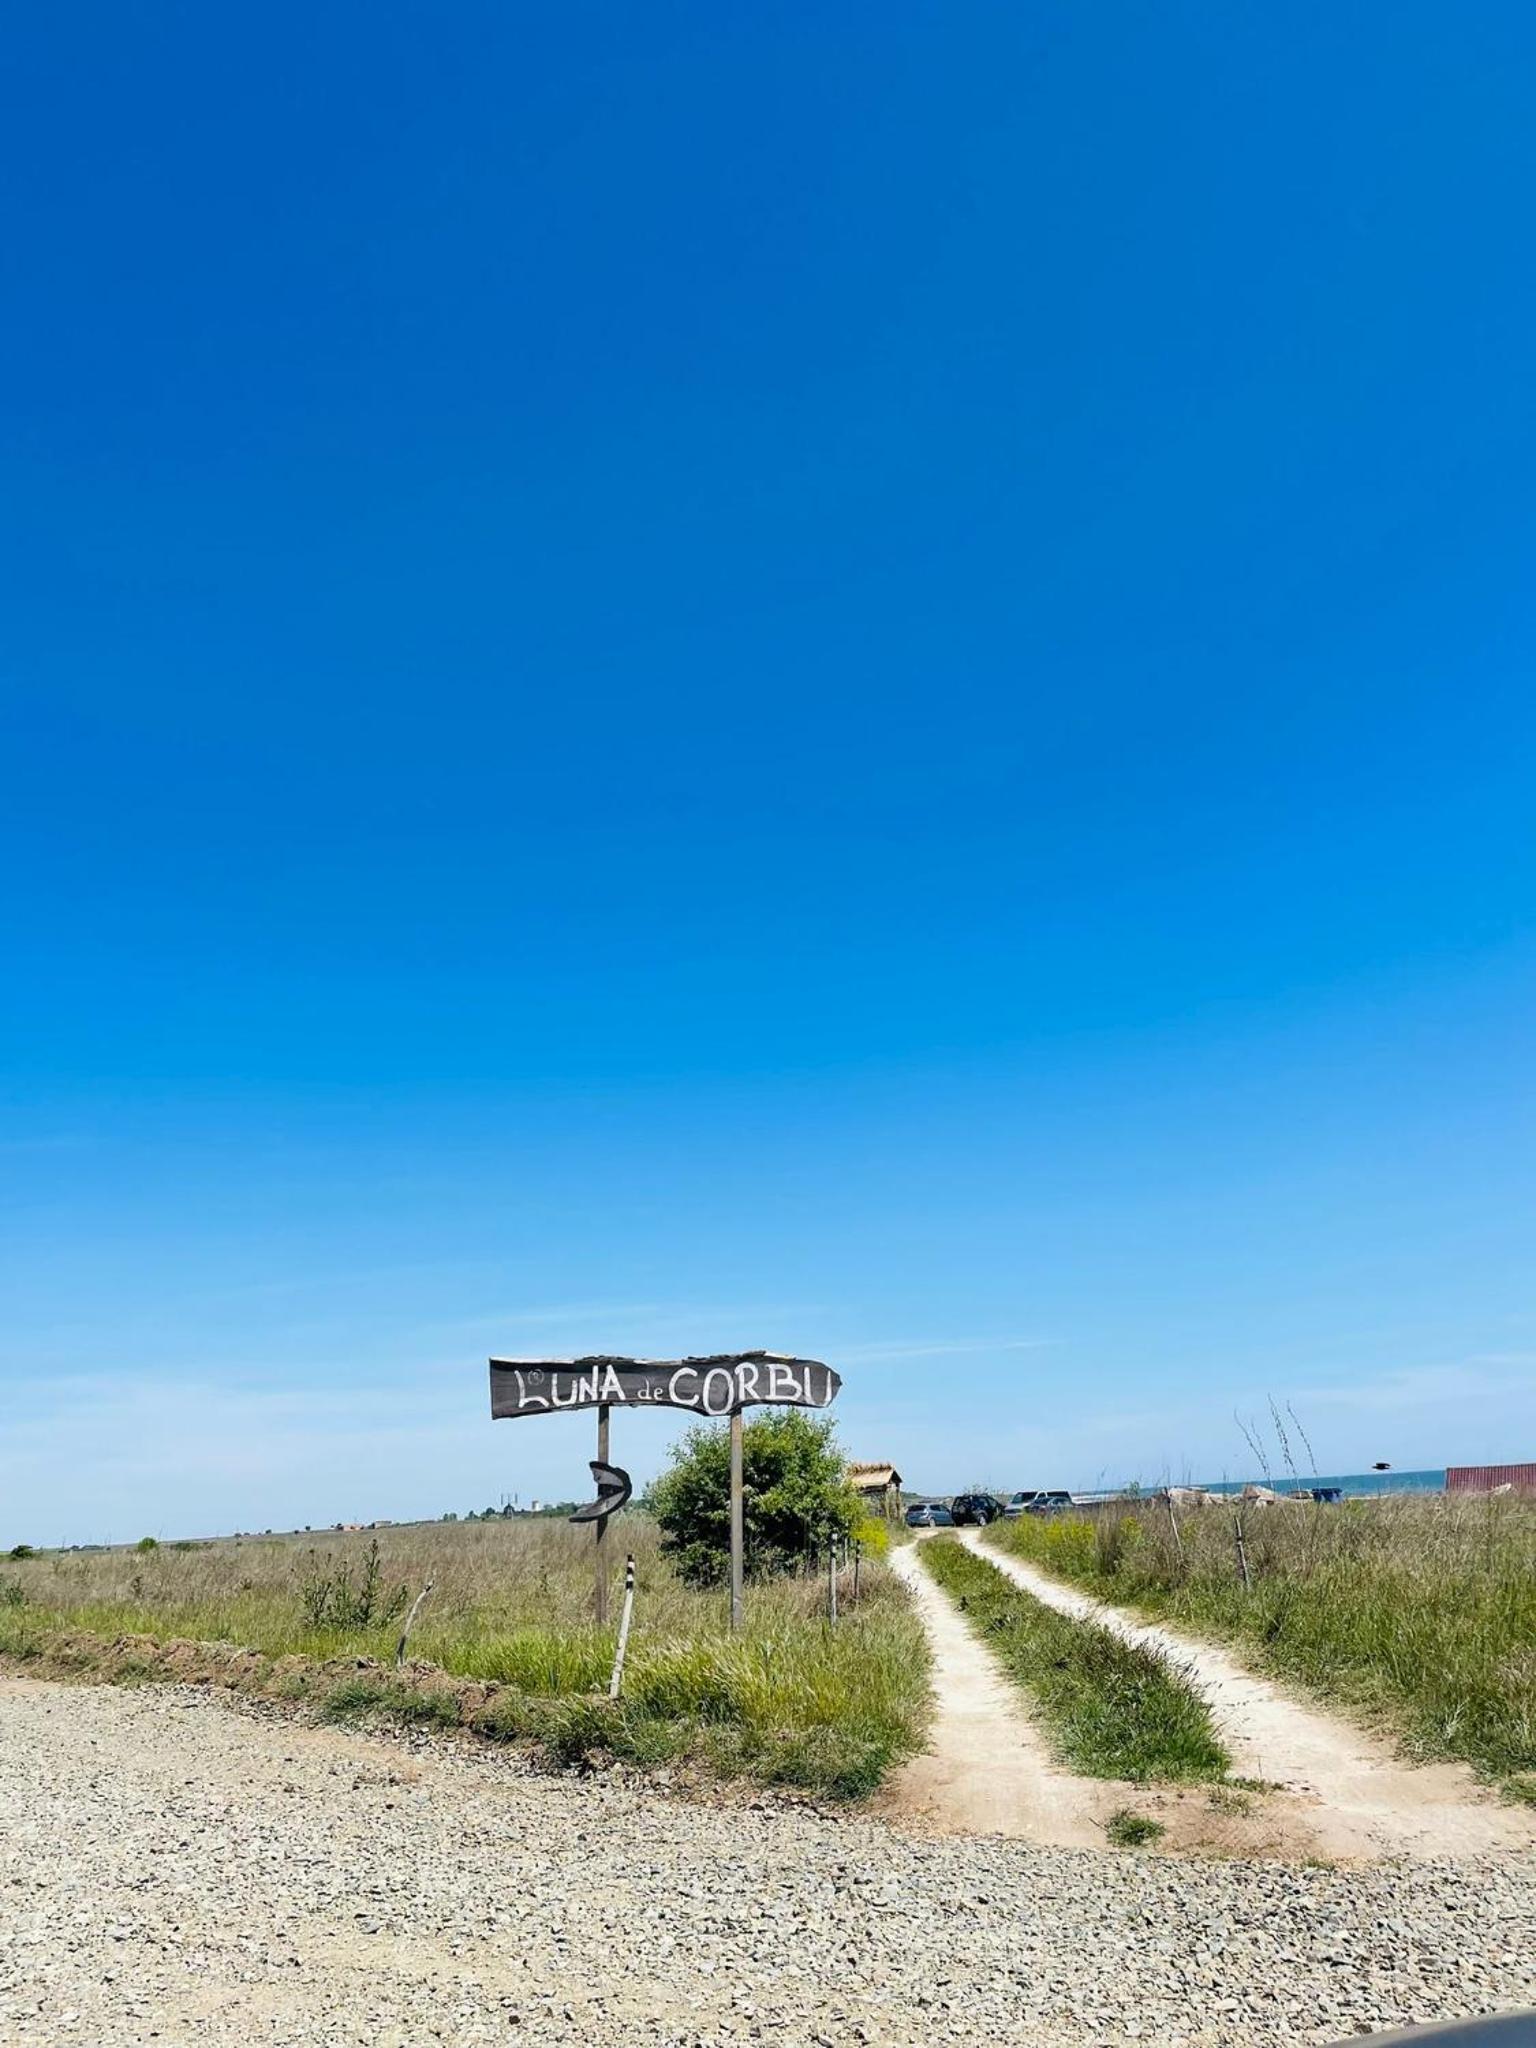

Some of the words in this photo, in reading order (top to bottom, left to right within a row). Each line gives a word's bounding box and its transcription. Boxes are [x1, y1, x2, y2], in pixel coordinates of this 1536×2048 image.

[515, 1364, 626, 1408] LUNA
[637, 1377, 664, 1401] de
[668, 1361, 832, 1415] CORBU
